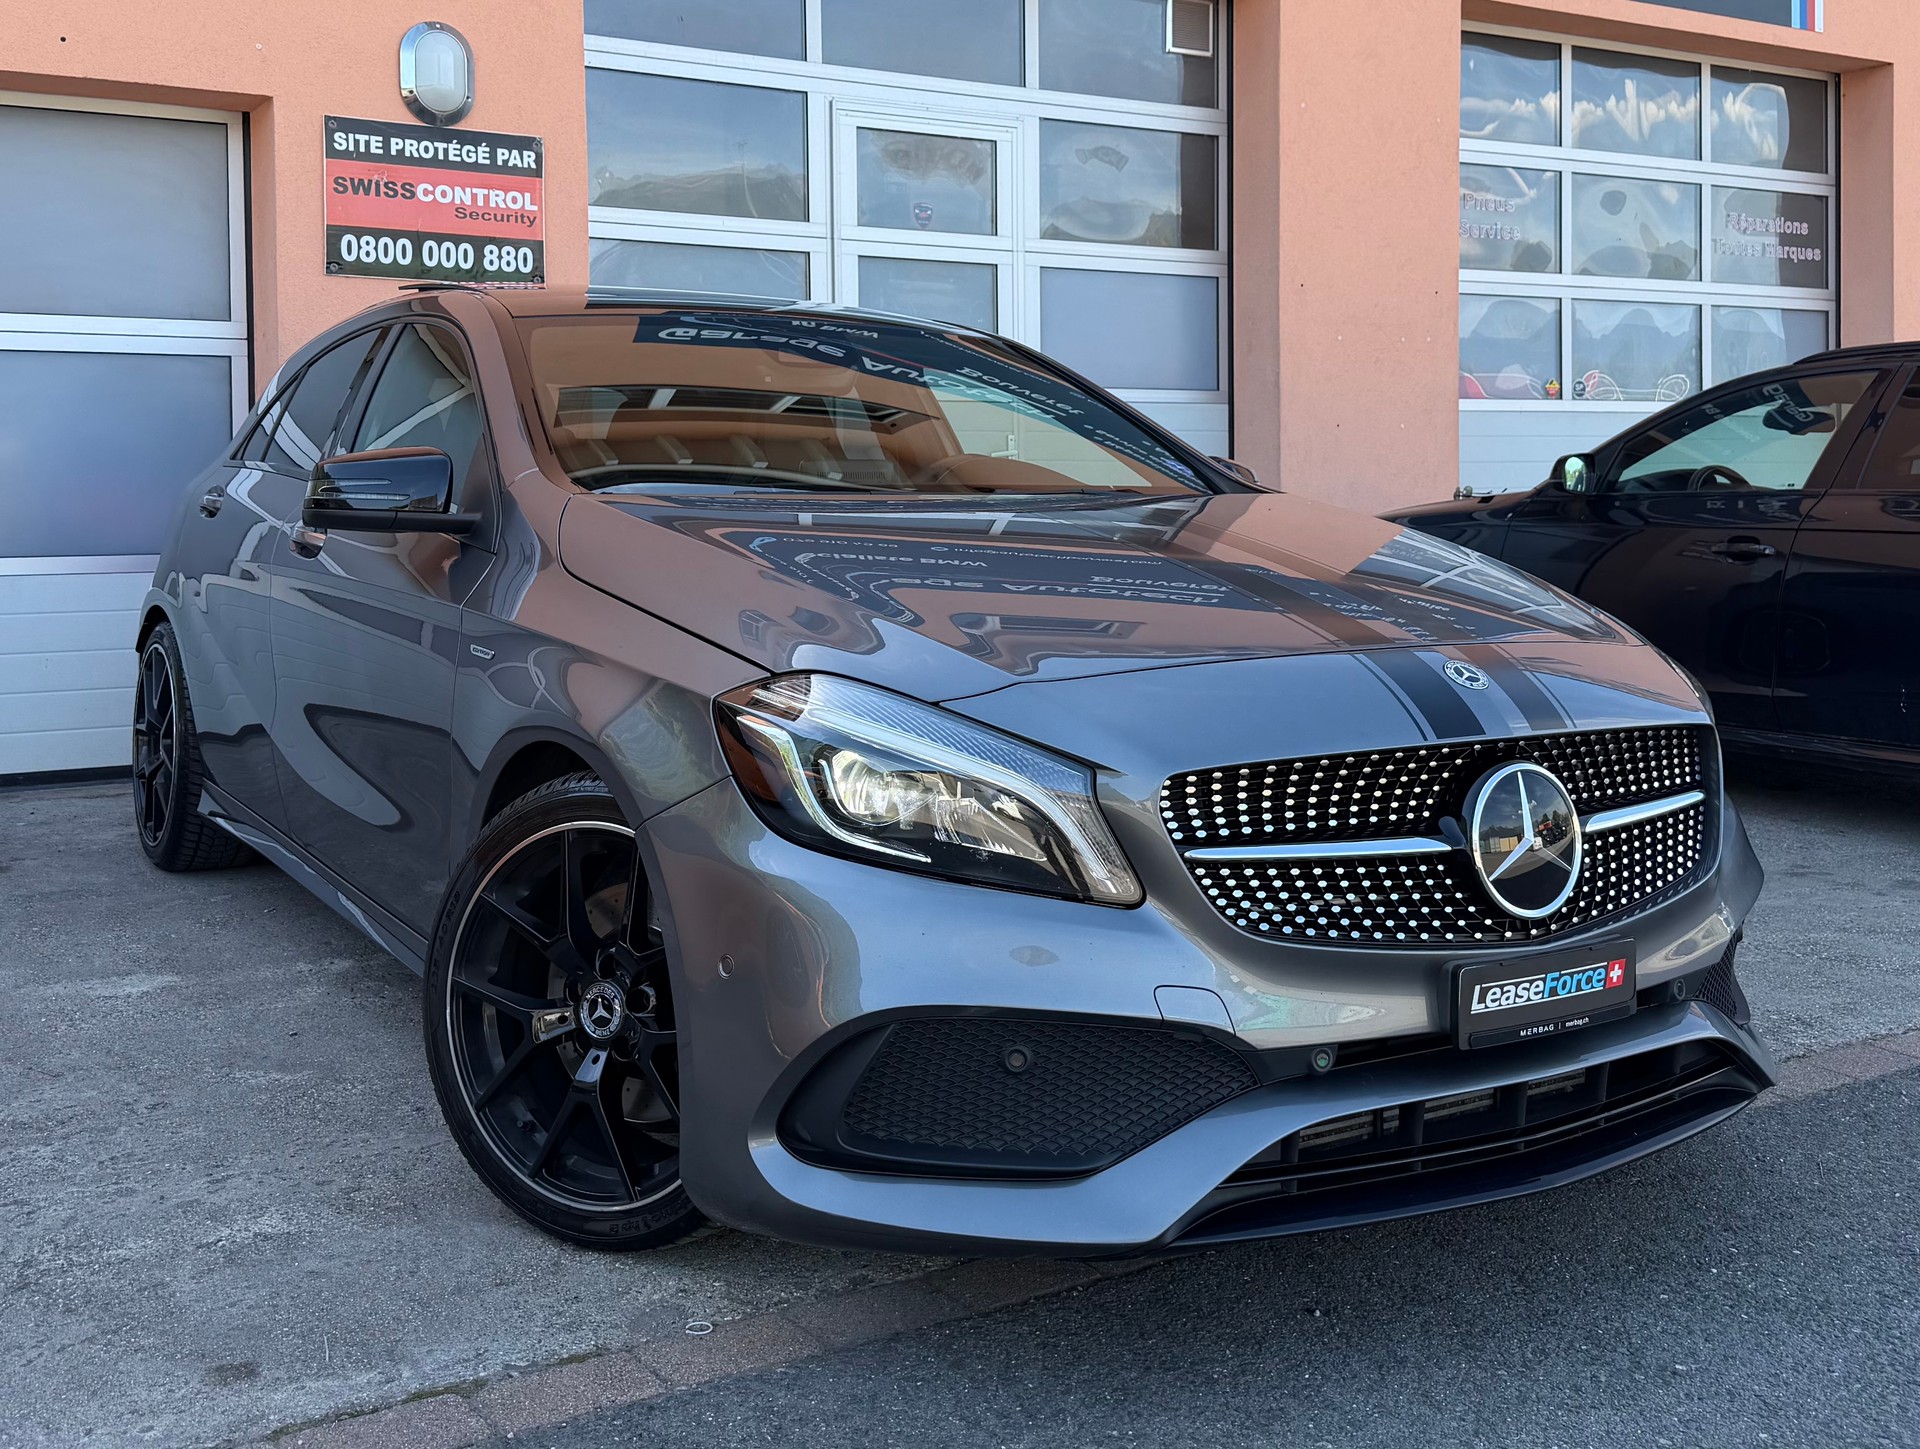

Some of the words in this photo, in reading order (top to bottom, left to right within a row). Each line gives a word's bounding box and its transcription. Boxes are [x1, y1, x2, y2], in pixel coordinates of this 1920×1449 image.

[333, 132, 384, 155] SITE
[390, 138, 491, 165] PROTÉGÉ
[496, 148, 537, 169] PAR
[1463, 191, 1516, 213] Pneus
[454, 206, 537, 228] Security
[1459, 218, 1521, 241] Service
[340, 234, 413, 266] 0800
[422, 240, 475, 270] 000
[483, 244, 534, 274] 880
[1762, 241, 1822, 263] Marques
[1470, 966, 1606, 1012] LeaseForce
[1519, 1023, 1555, 1037] MERBAG
